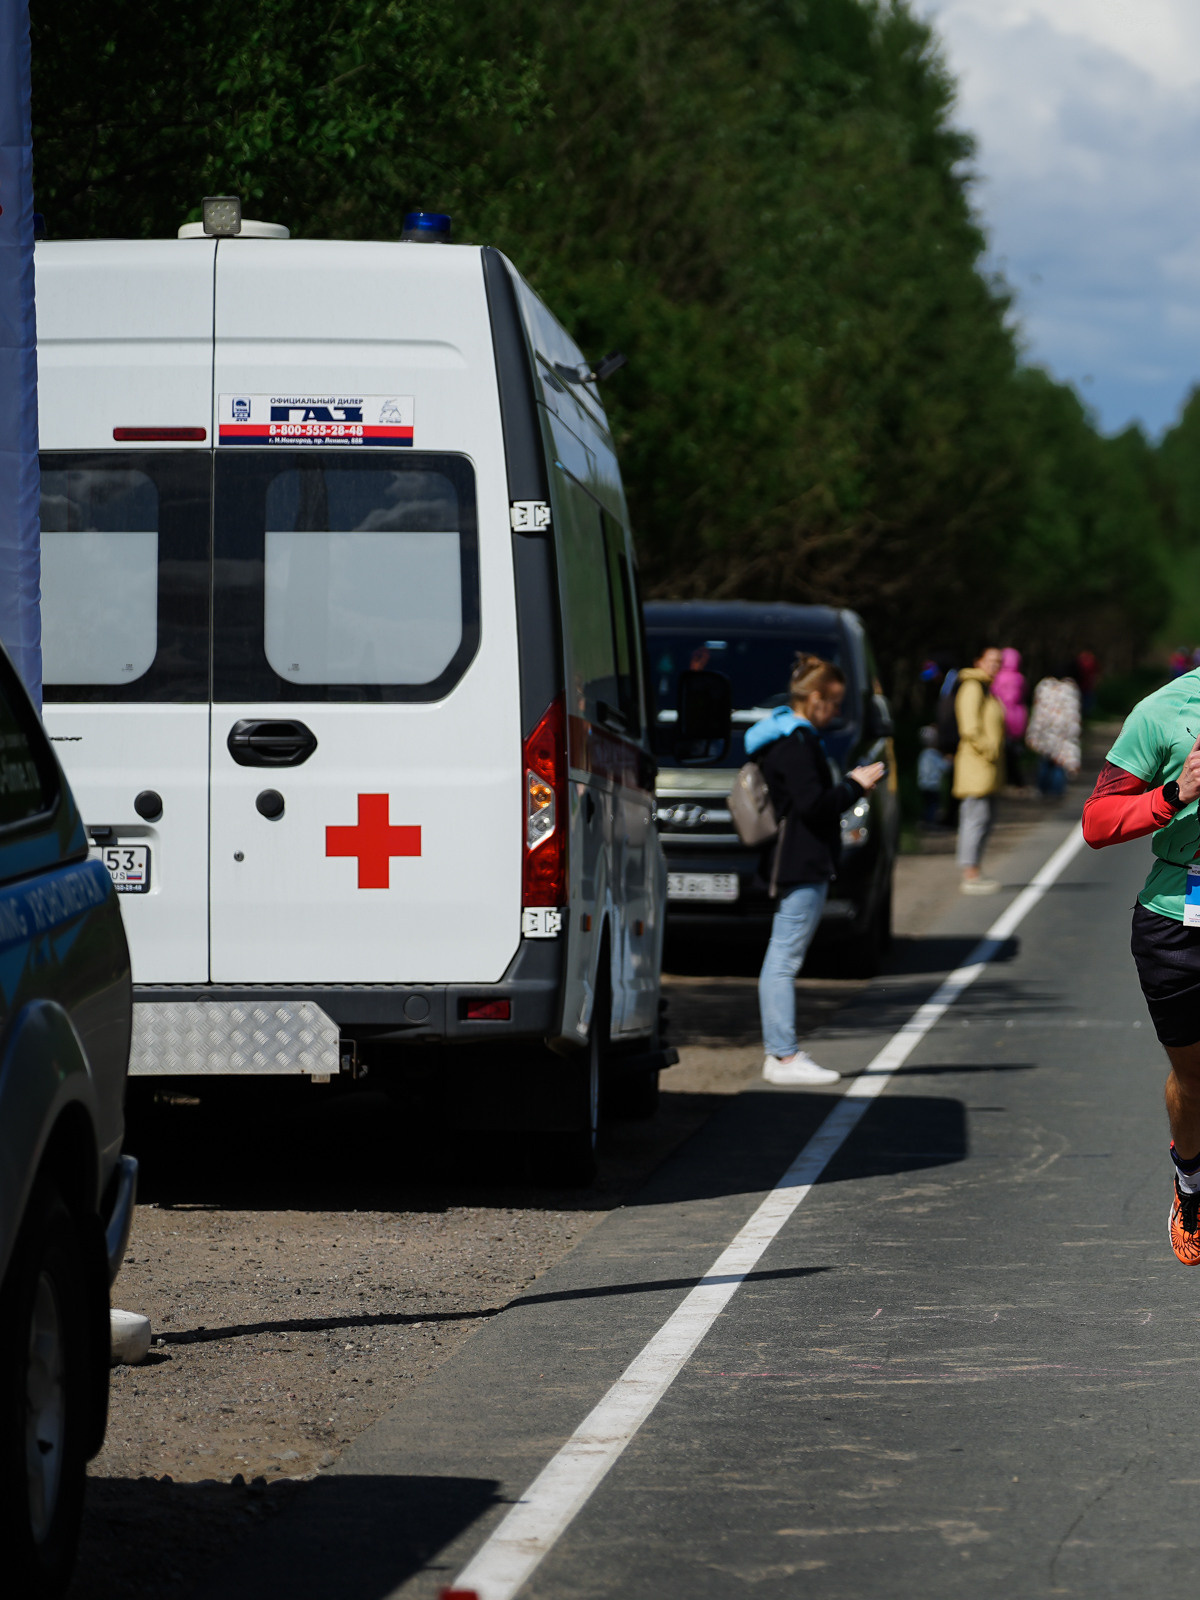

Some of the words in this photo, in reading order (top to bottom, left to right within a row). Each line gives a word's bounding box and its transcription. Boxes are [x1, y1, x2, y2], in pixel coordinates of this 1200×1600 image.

[270, 406, 363, 422] ГАЗ
[269, 425, 364, 436] 8-800-555-28-48
[107, 850, 135, 871] 53
